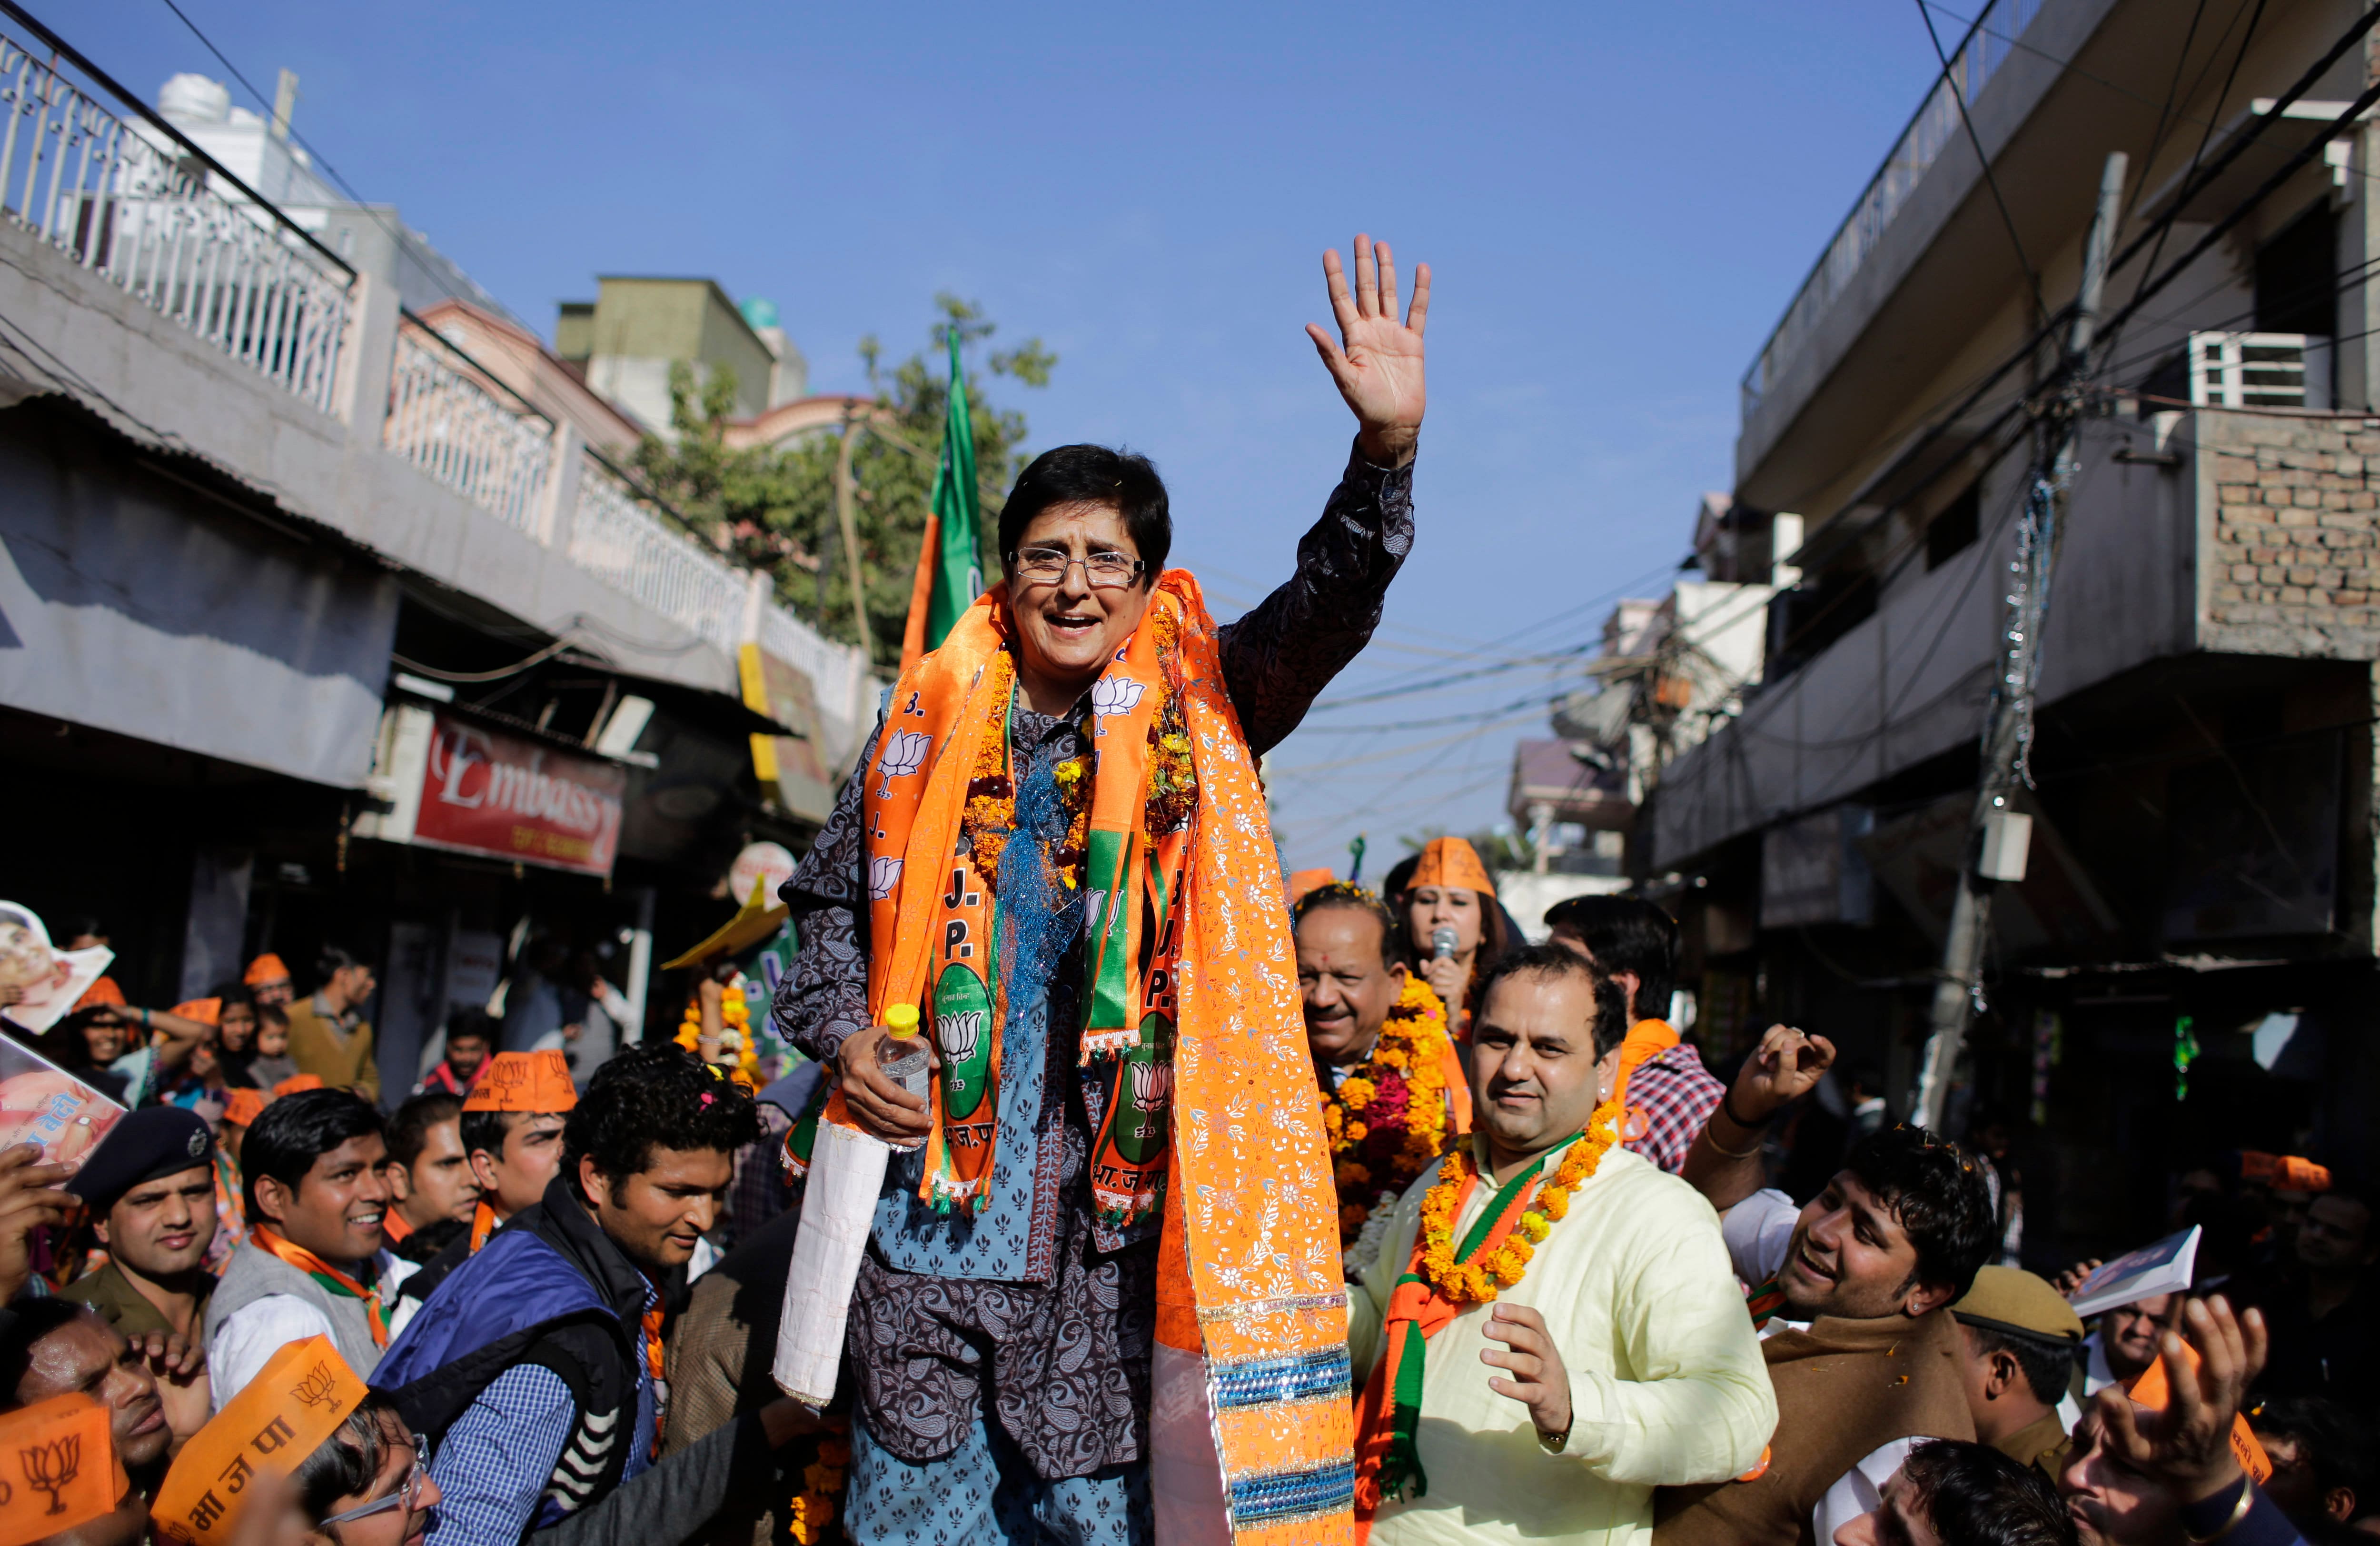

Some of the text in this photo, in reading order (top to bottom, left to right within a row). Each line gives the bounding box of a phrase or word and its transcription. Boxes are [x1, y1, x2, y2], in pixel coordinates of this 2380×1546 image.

[943, 867, 980, 910] J.
[944, 918, 974, 961] P.
[188, 1414, 297, 1531] भा ज पा
